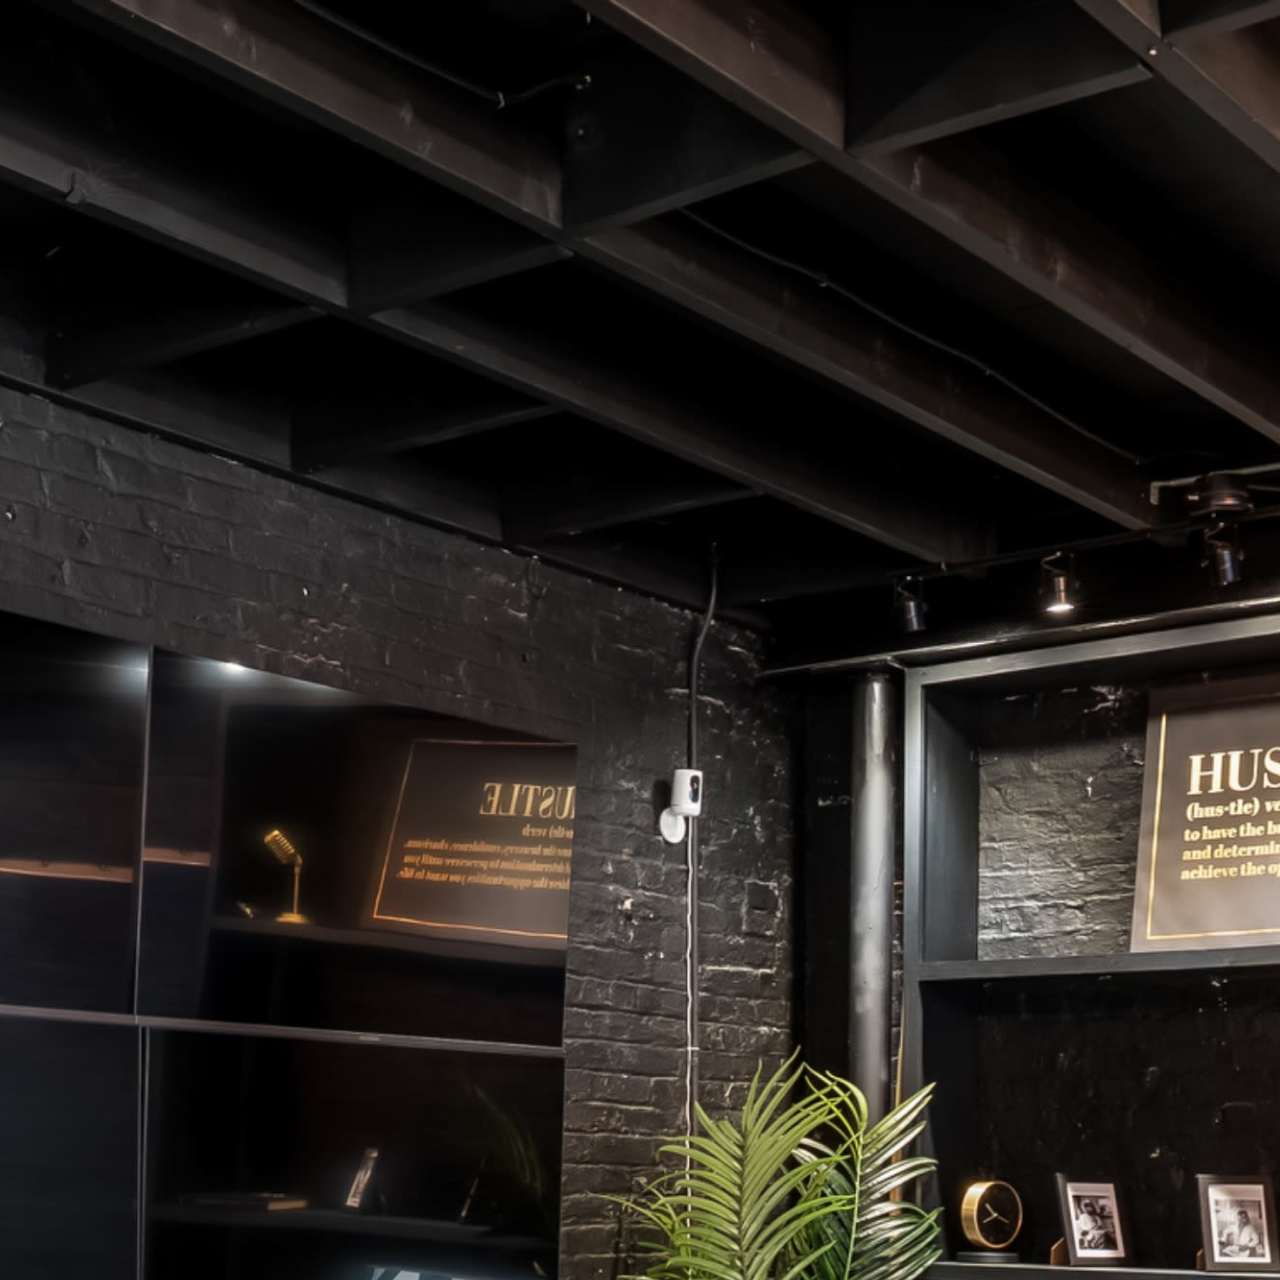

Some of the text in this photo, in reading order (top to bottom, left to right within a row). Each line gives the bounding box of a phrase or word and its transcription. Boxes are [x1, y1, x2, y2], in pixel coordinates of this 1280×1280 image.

[1183, 828, 1200, 842] to
[1202, 825, 1237, 841] have
[1239, 822, 1265, 838] the
[1182, 845, 1211, 861] and
[1180, 864, 1238, 880] achieve
[1240, 861, 1266, 877] the
